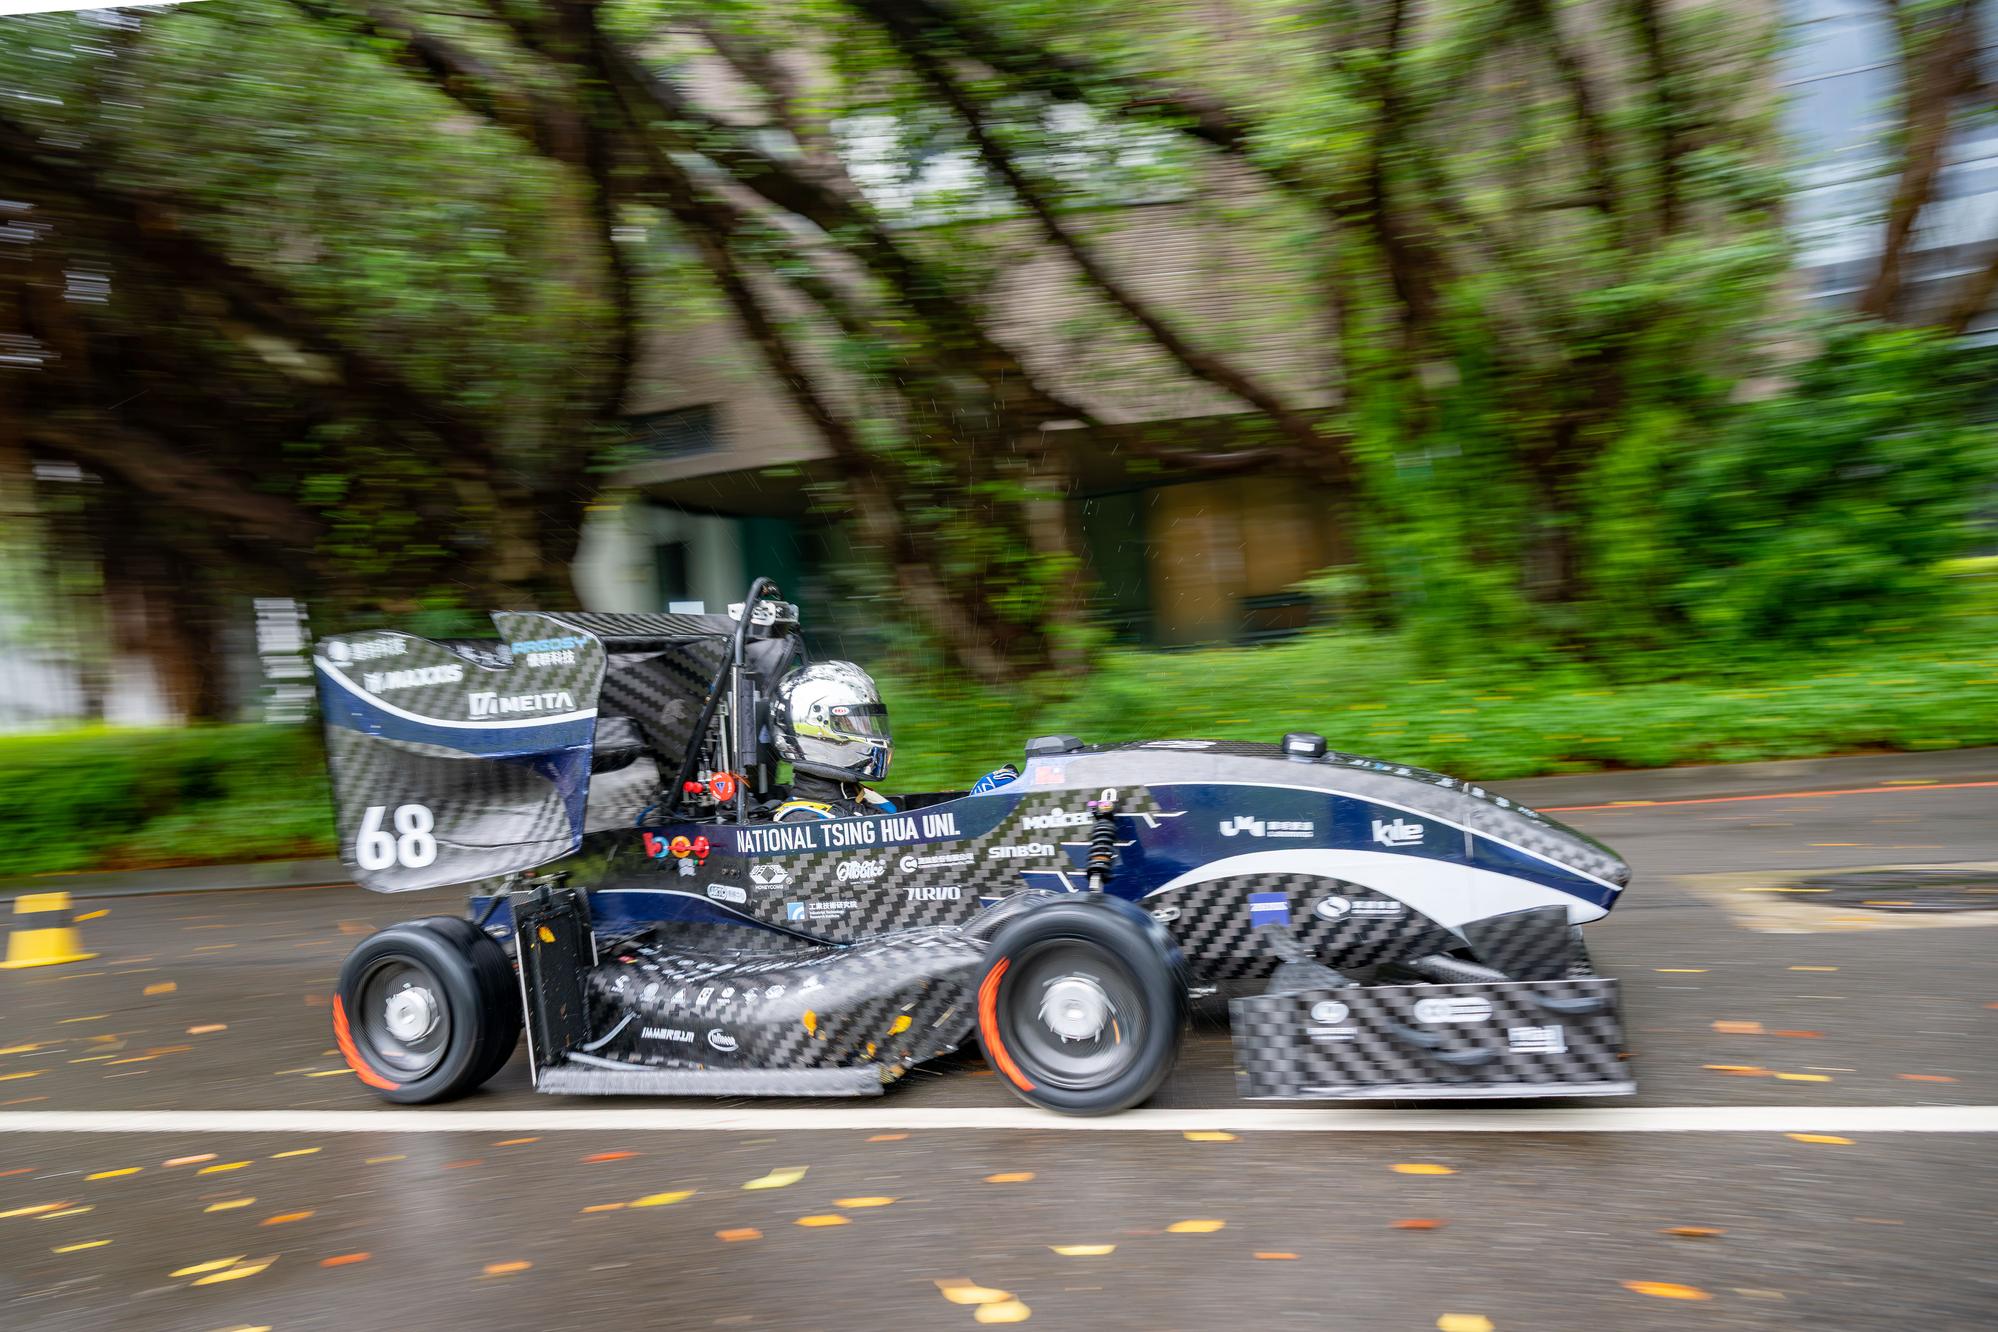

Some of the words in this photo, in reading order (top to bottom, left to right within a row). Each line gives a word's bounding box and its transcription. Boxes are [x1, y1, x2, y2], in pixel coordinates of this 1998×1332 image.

[356, 804, 438, 871] 68
[736, 826, 817, 853] NATIONAL
[820, 820, 875, 847] TSING
[880, 816, 919, 842] HUA
